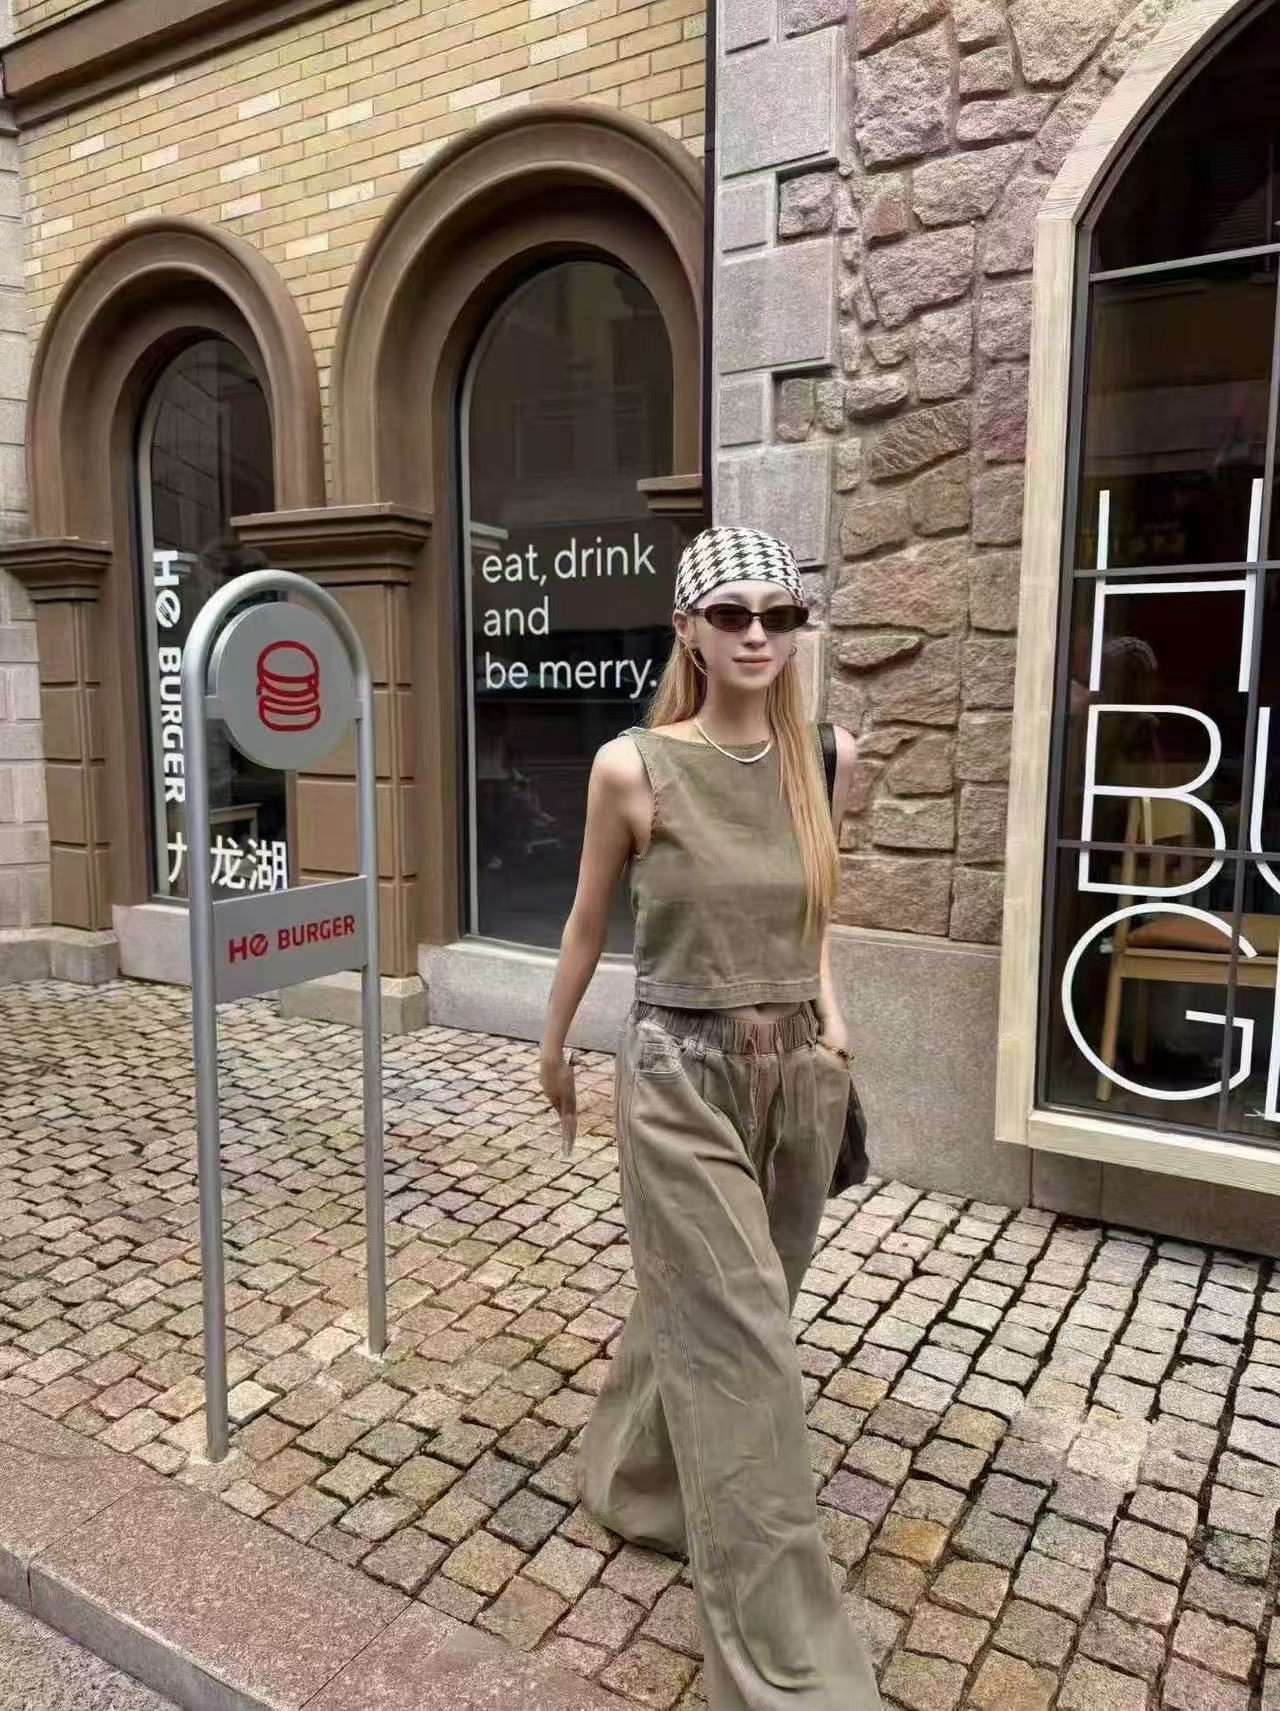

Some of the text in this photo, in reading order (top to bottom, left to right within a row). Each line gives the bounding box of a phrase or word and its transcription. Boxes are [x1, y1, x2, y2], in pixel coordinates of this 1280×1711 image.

[482, 533, 656, 586] eat, drink
[483, 595, 549, 637] and
[485, 651, 657, 698] be merry.
[158, 647, 186, 803] BURGER
[1078, 704, 1280, 897] B
[277, 914, 356, 950] BURGER
[1061, 902, 1280, 1122] G
